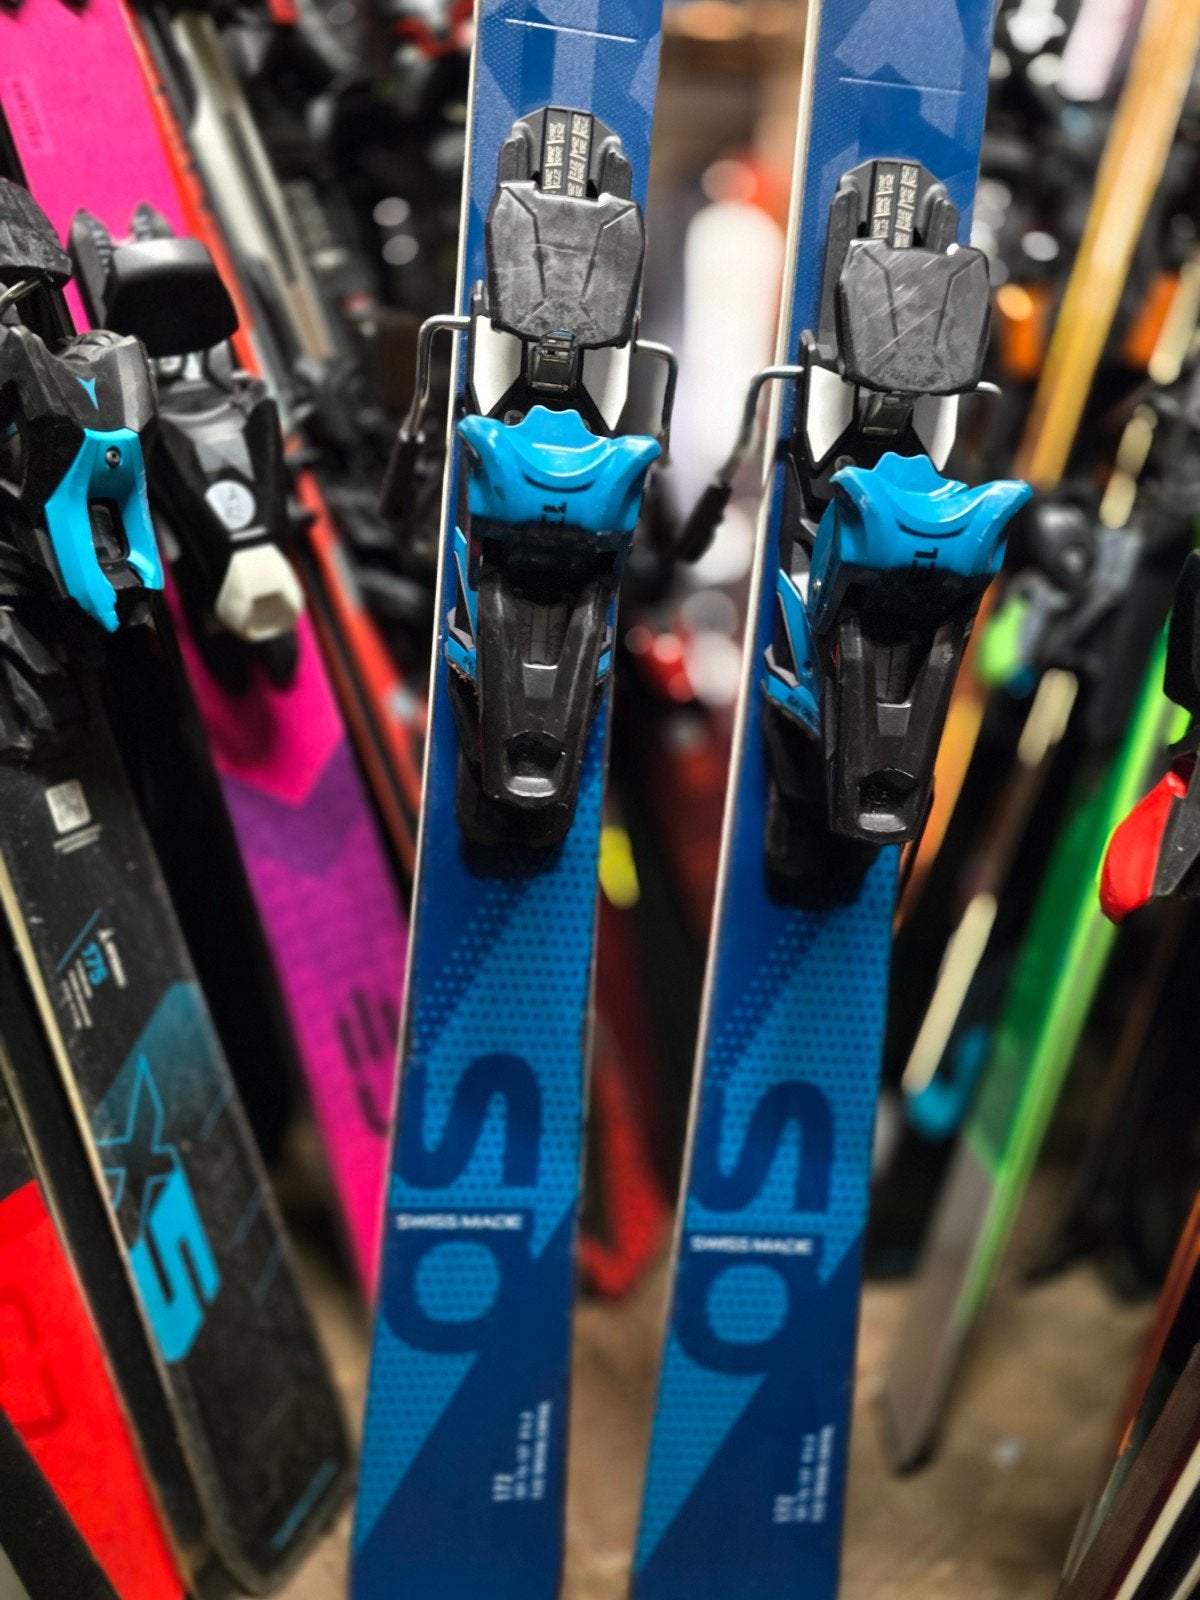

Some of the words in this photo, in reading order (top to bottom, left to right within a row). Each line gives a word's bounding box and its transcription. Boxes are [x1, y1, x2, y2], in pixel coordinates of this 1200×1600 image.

[396, 1213, 458, 1231] SWISS
[460, 1213, 523, 1232] MADE
[689, 1234, 751, 1254] SWISS
[752, 1236, 814, 1257] MADE
